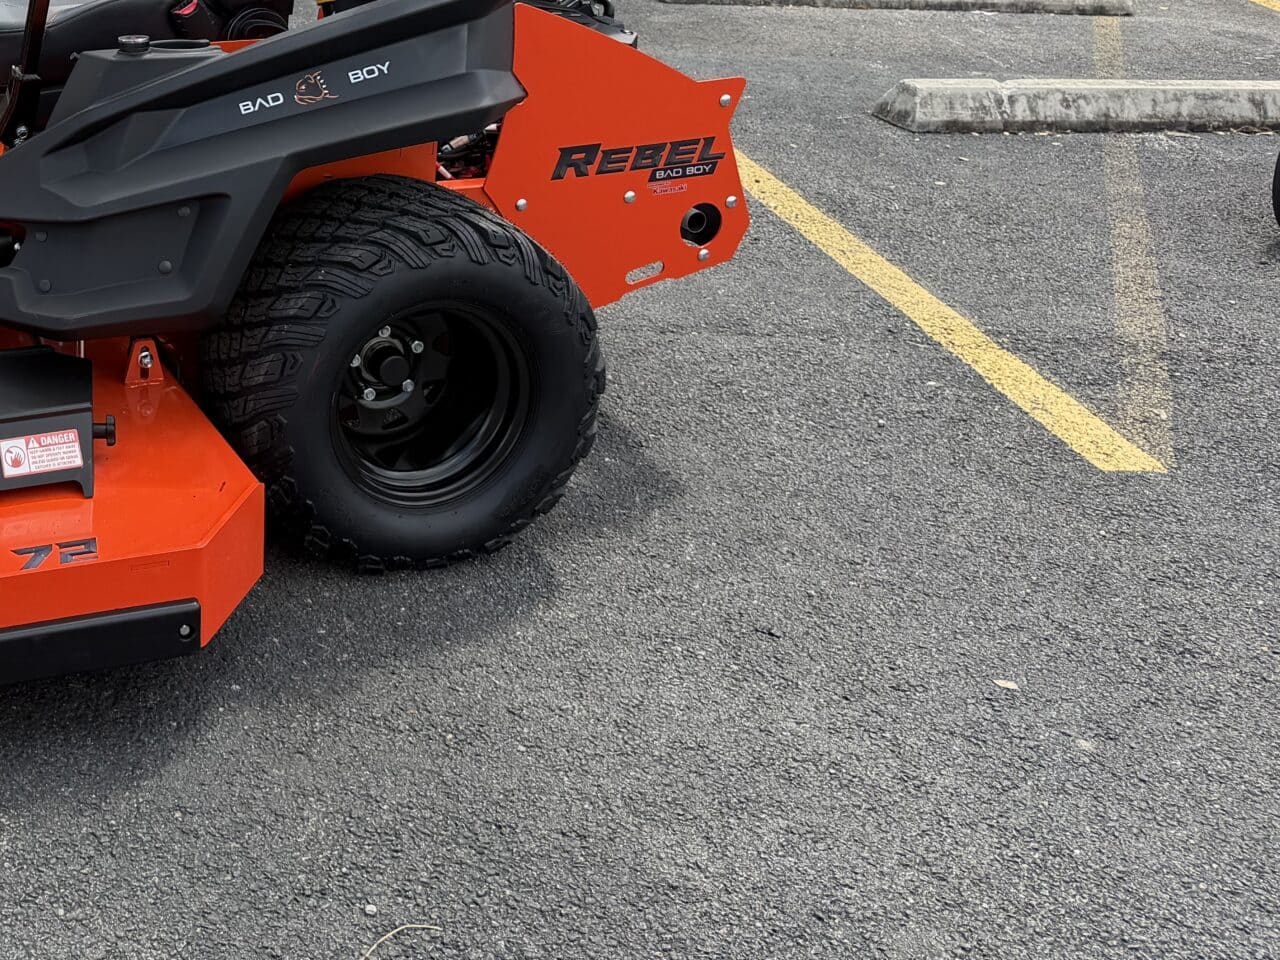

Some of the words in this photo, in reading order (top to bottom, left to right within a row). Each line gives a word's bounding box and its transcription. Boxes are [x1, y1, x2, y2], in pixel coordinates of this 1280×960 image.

[239, 92, 284, 115] BAD
[348, 61, 391, 84] BOY
[551, 136, 726, 181] REBEL
[656, 168, 682, 179] BAD
[686, 164, 712, 175] BOY
[40, 432, 76, 446] DANGER
[10, 537, 99, 570] 72
